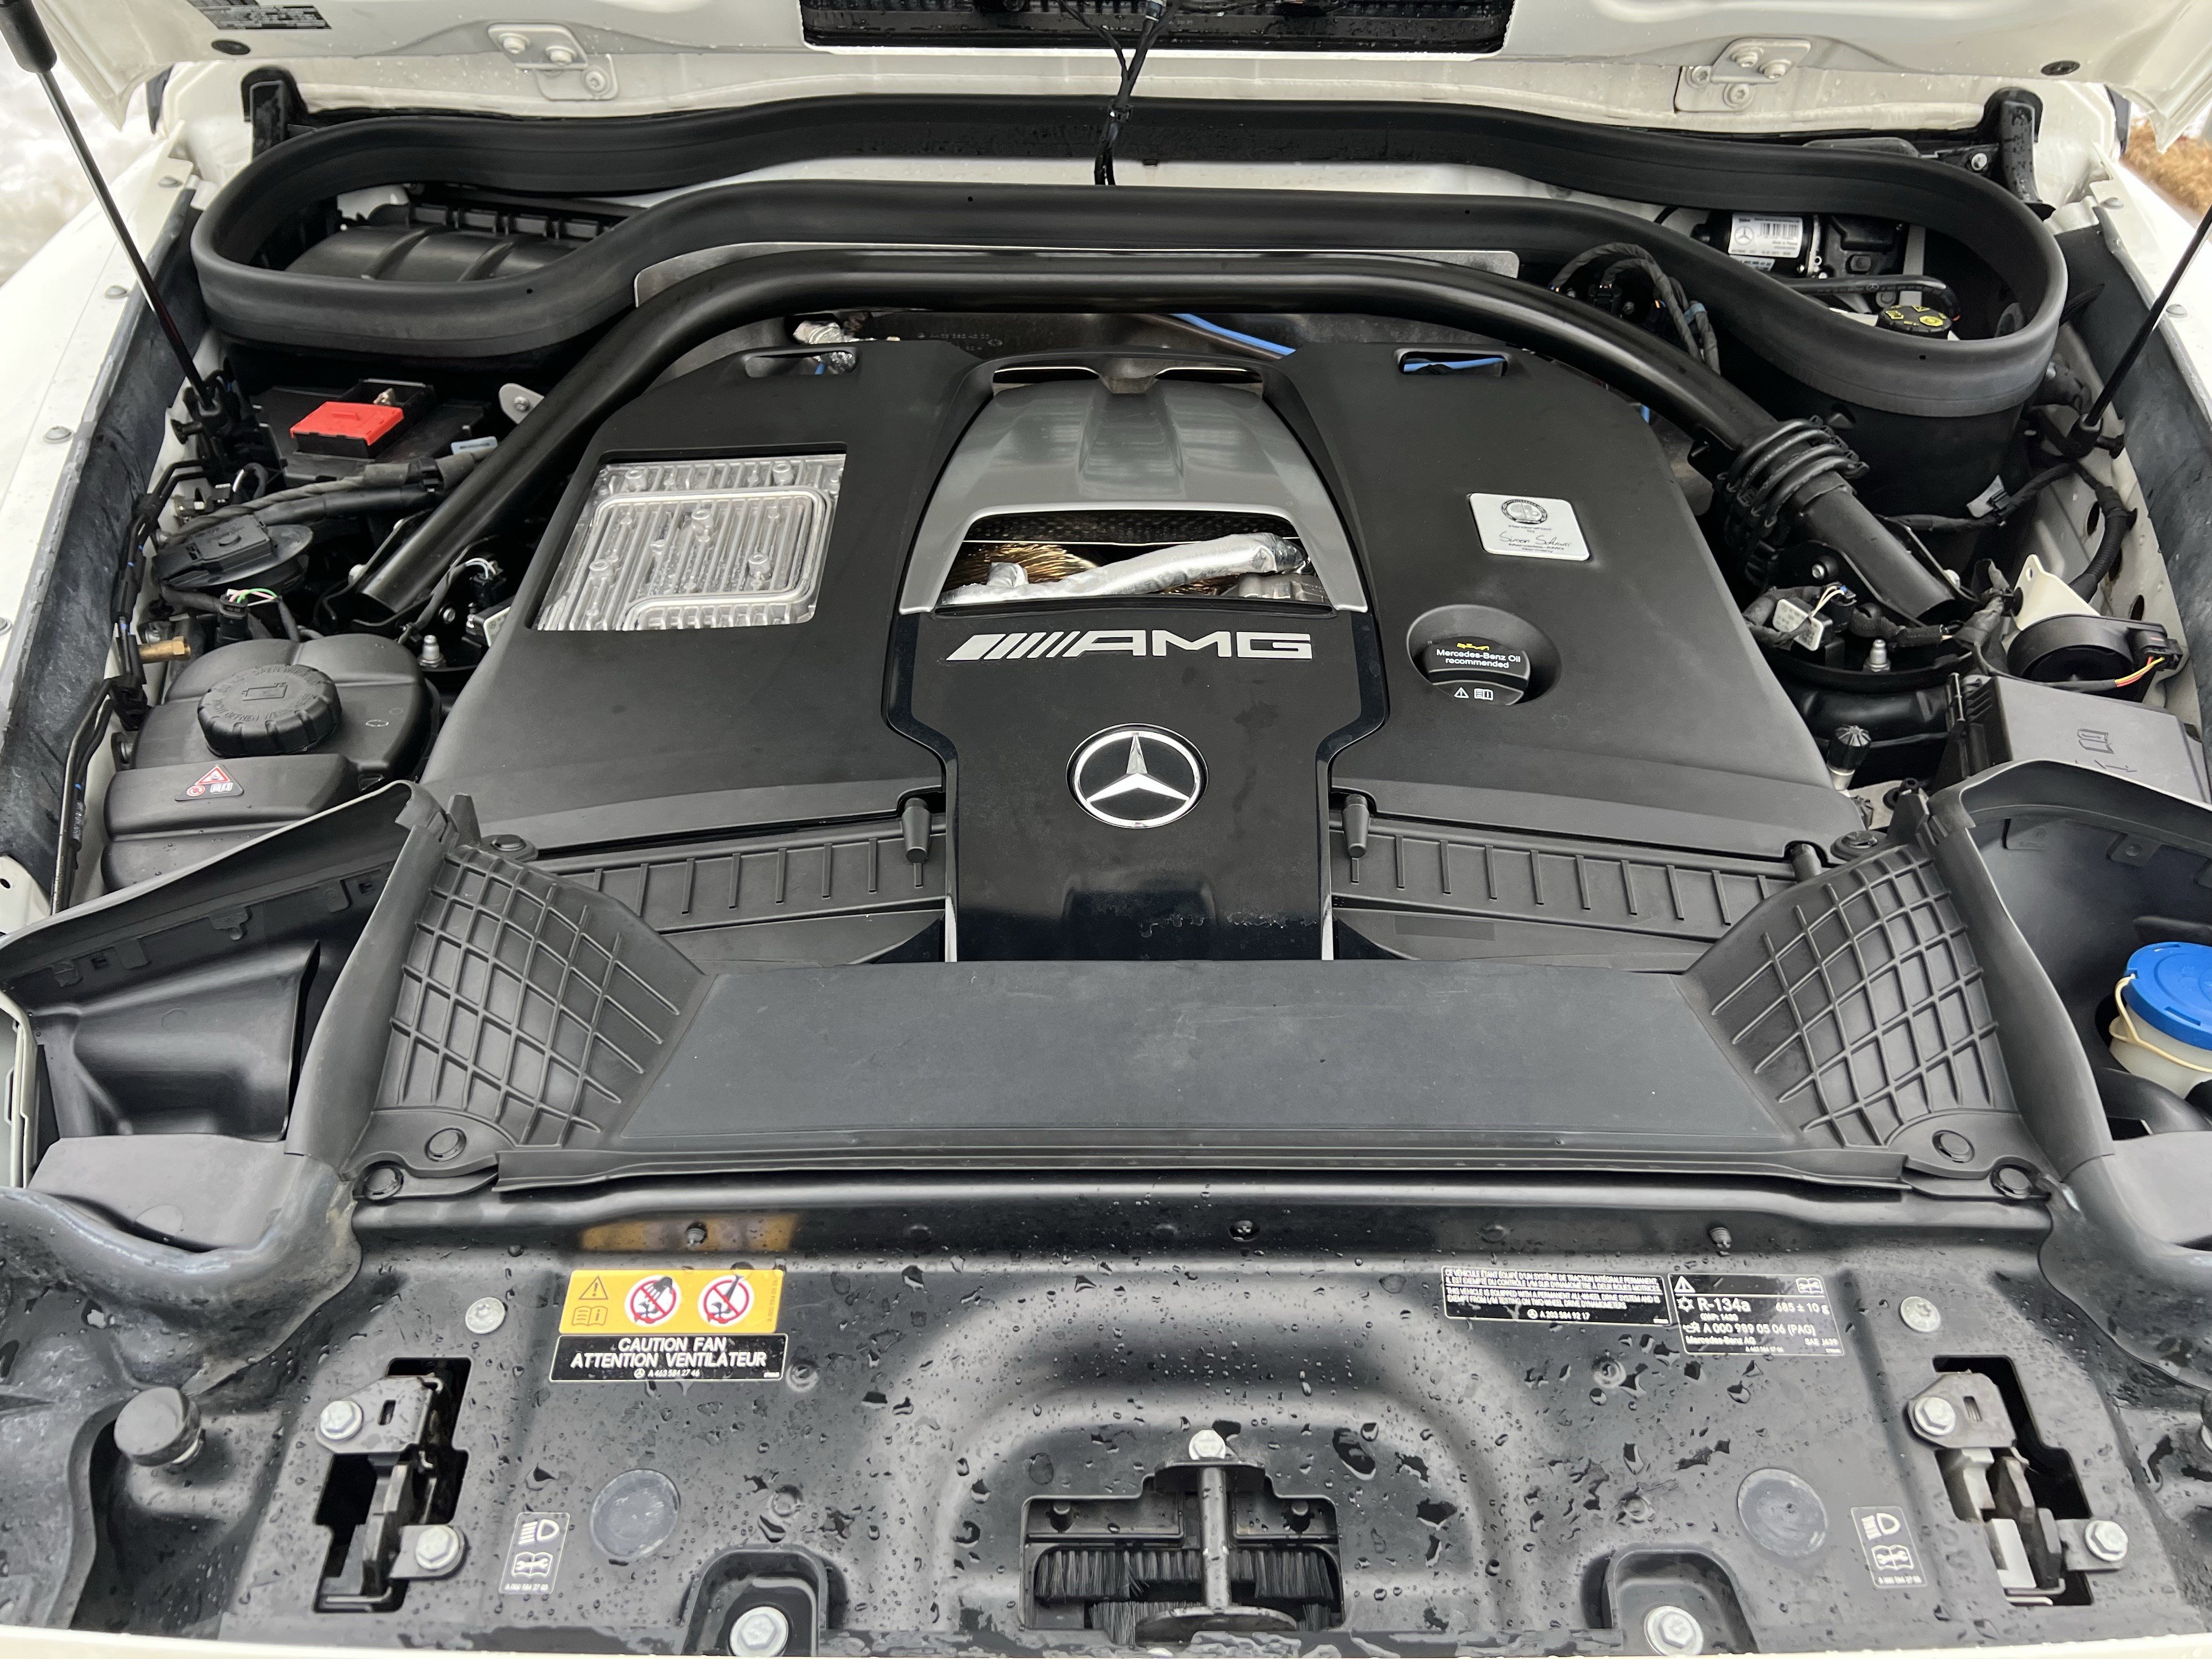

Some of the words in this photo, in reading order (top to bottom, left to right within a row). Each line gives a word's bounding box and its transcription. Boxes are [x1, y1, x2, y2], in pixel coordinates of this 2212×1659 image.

[1062, 629, 1312, 659] AMG
[1436, 648, 1506, 662] Mercedes-Benz
[1508, 654, 1521, 663] Oil
[1445, 658, 1509, 669] recommended
[1697, 1297, 1752, 1312] R-134a
[1775, 1302, 1795, 1312] 685
[1806, 1302, 1820, 1313] 10
[1582, 1312, 1590, 1321] 17
[1703, 1323, 1712, 1333] A
[1712, 1323, 1733, 1333] 000
[1734, 1323, 1754, 1334] 989
[1756, 1323, 1770, 1334] 05
[1771, 1323, 1785, 1334] 06
[1787, 1323, 1816, 1336] (PAG)
[618, 1337, 688, 1352] CAUTION
[693, 1337, 727, 1352] FAN
[1685, 1336, 1743, 1345] Mercedes-Benz
[1744, 1336, 1756, 1345] AG
[569, 1352, 658, 1369] ATTENTION
[665, 1351, 767, 1368] VENTILATEUR
[647, 1369, 654, 1377] A
